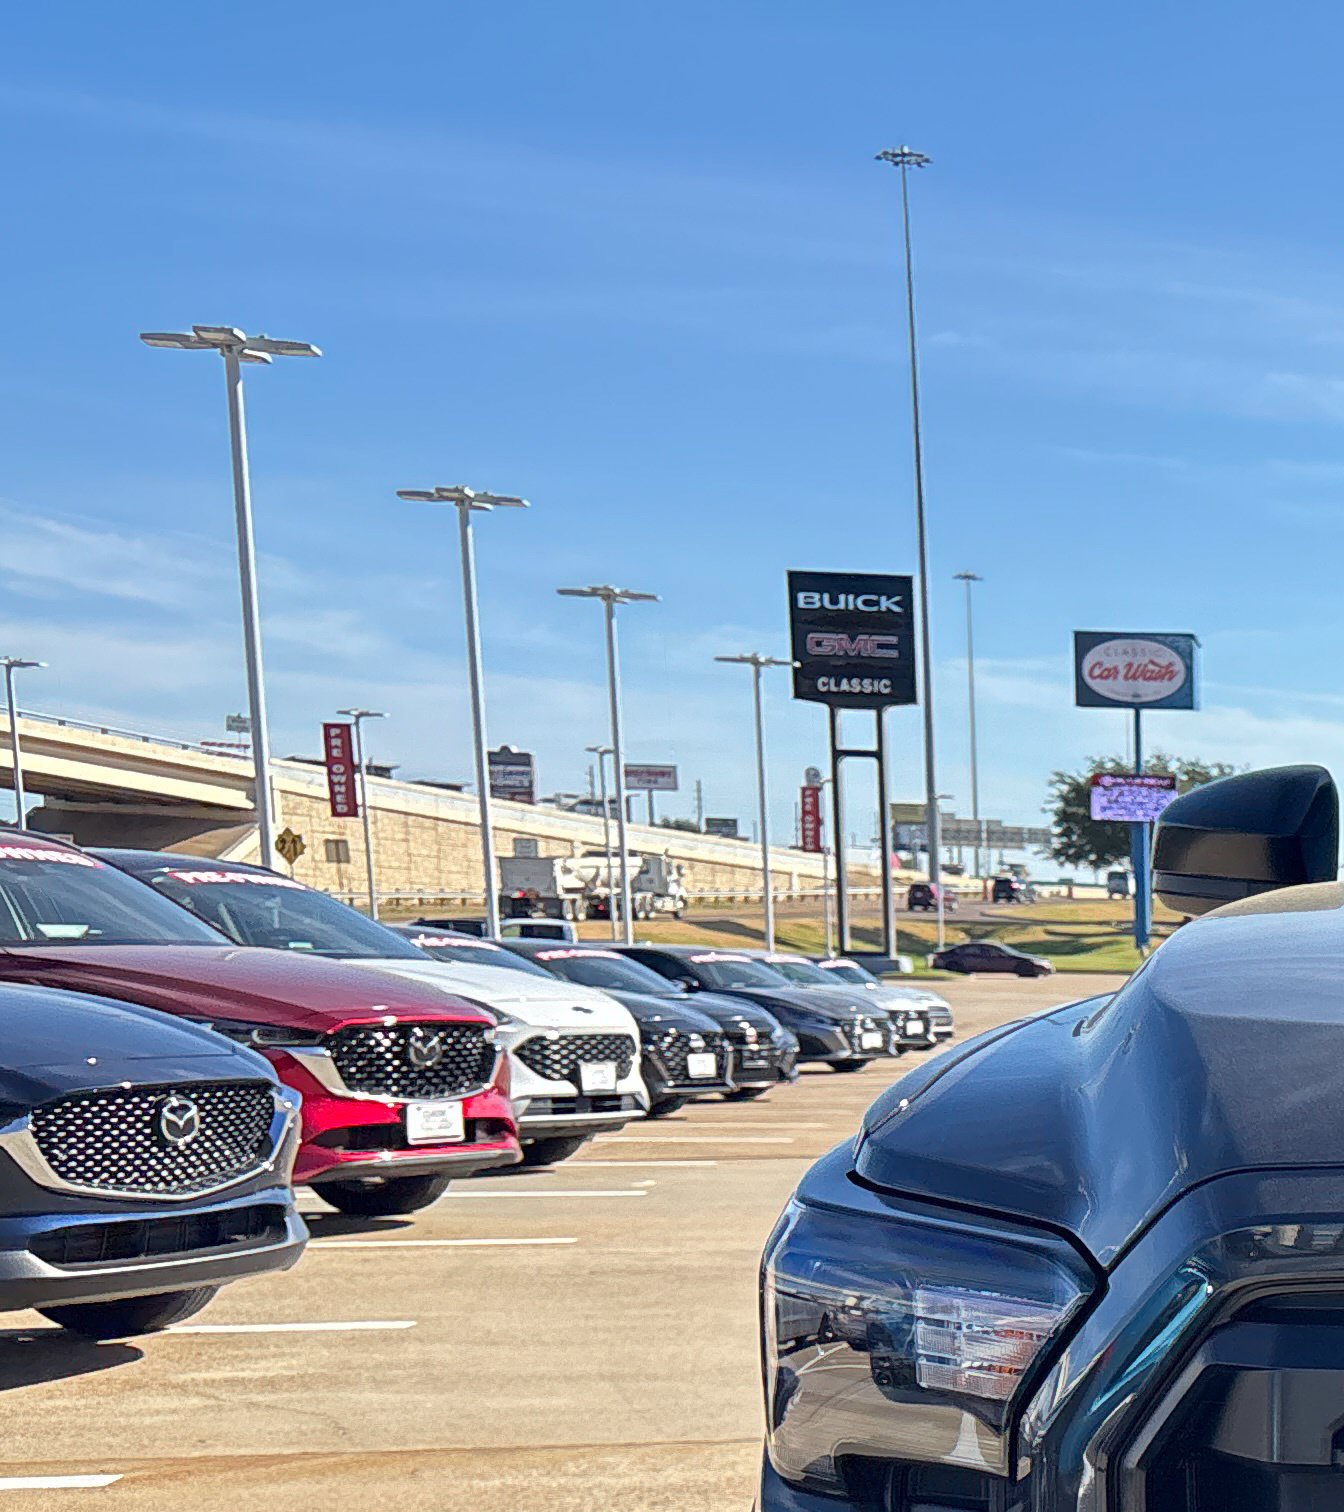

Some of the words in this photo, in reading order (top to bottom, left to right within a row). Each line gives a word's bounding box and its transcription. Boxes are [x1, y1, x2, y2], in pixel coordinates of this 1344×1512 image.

[796, 591, 904, 613] BUICK
[806, 632, 899, 658] GMC
[1088, 660, 1119, 681] Car
[1123, 658, 1180, 682] Wash
[816, 676, 892, 694] CLASSIC
